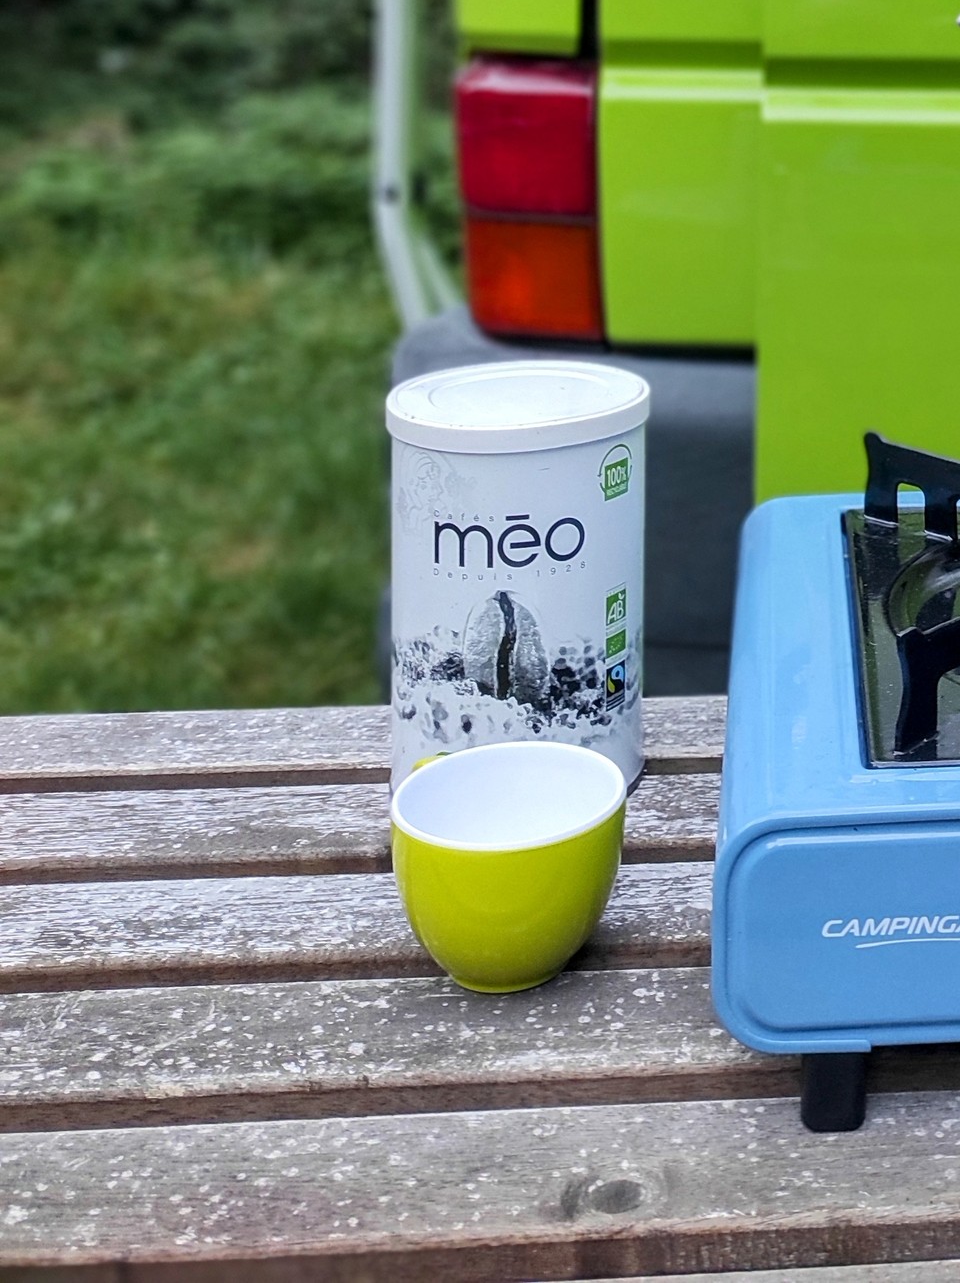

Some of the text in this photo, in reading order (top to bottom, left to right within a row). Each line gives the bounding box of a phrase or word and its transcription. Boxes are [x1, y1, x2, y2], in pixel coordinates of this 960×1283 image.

[433, 509, 495, 522] Cafés
[433, 561, 586, 581] Depuis 1928
[607, 599, 625, 624] AB
